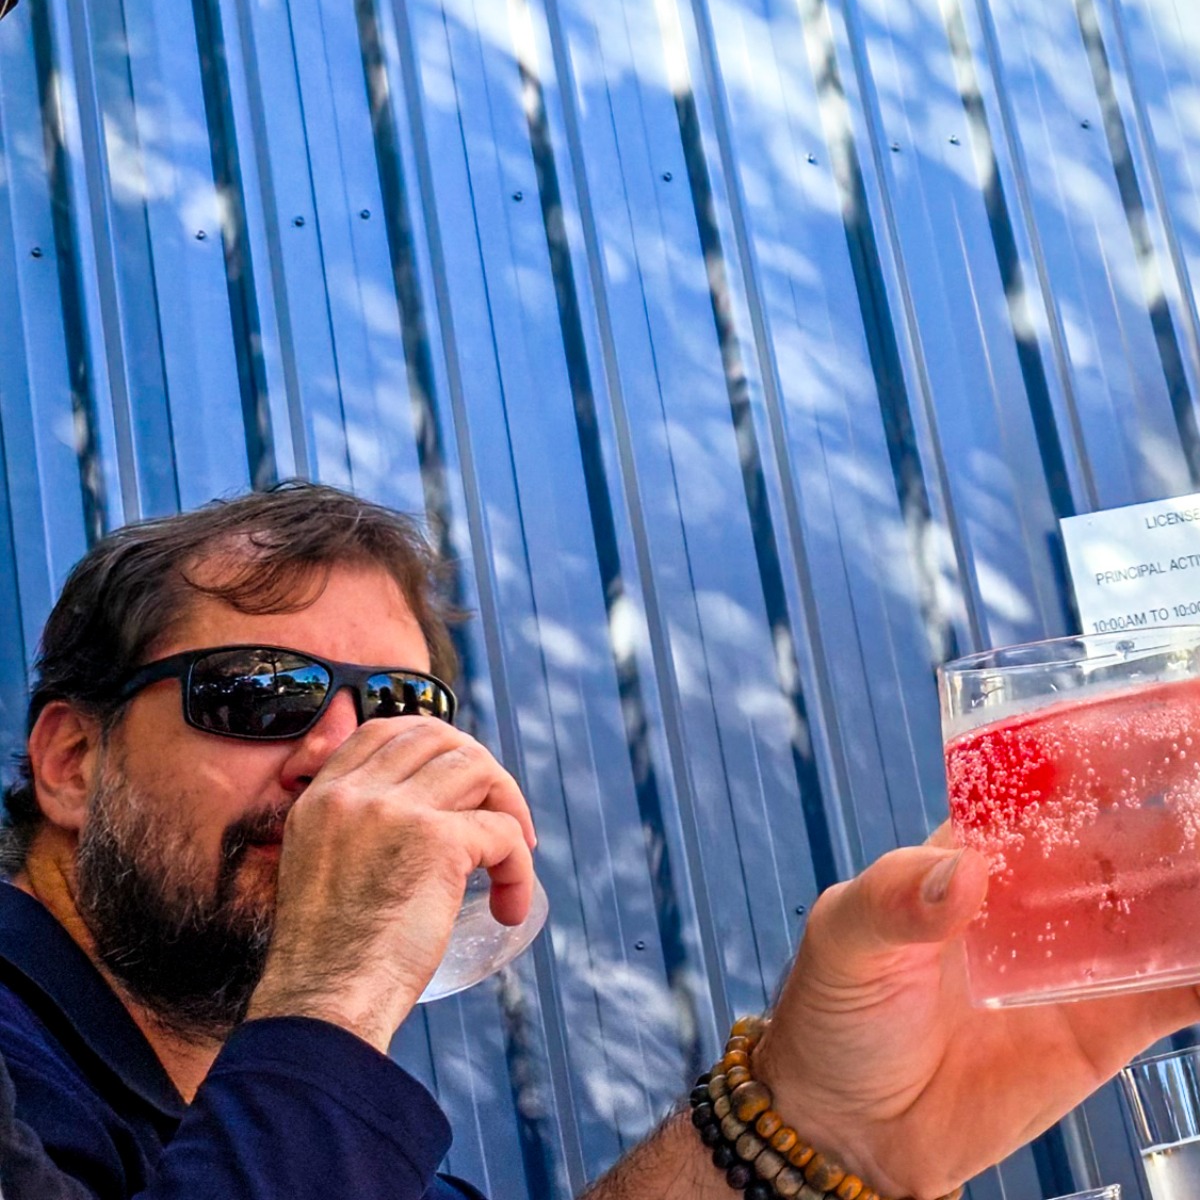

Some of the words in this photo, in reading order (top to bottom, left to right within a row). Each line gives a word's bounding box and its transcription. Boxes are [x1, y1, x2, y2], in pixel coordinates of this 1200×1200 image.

[1095, 562, 1167, 586] PRINCIPAL
[1092, 612, 1148, 634] 10:00AM
[1149, 607, 1169, 624] TO
